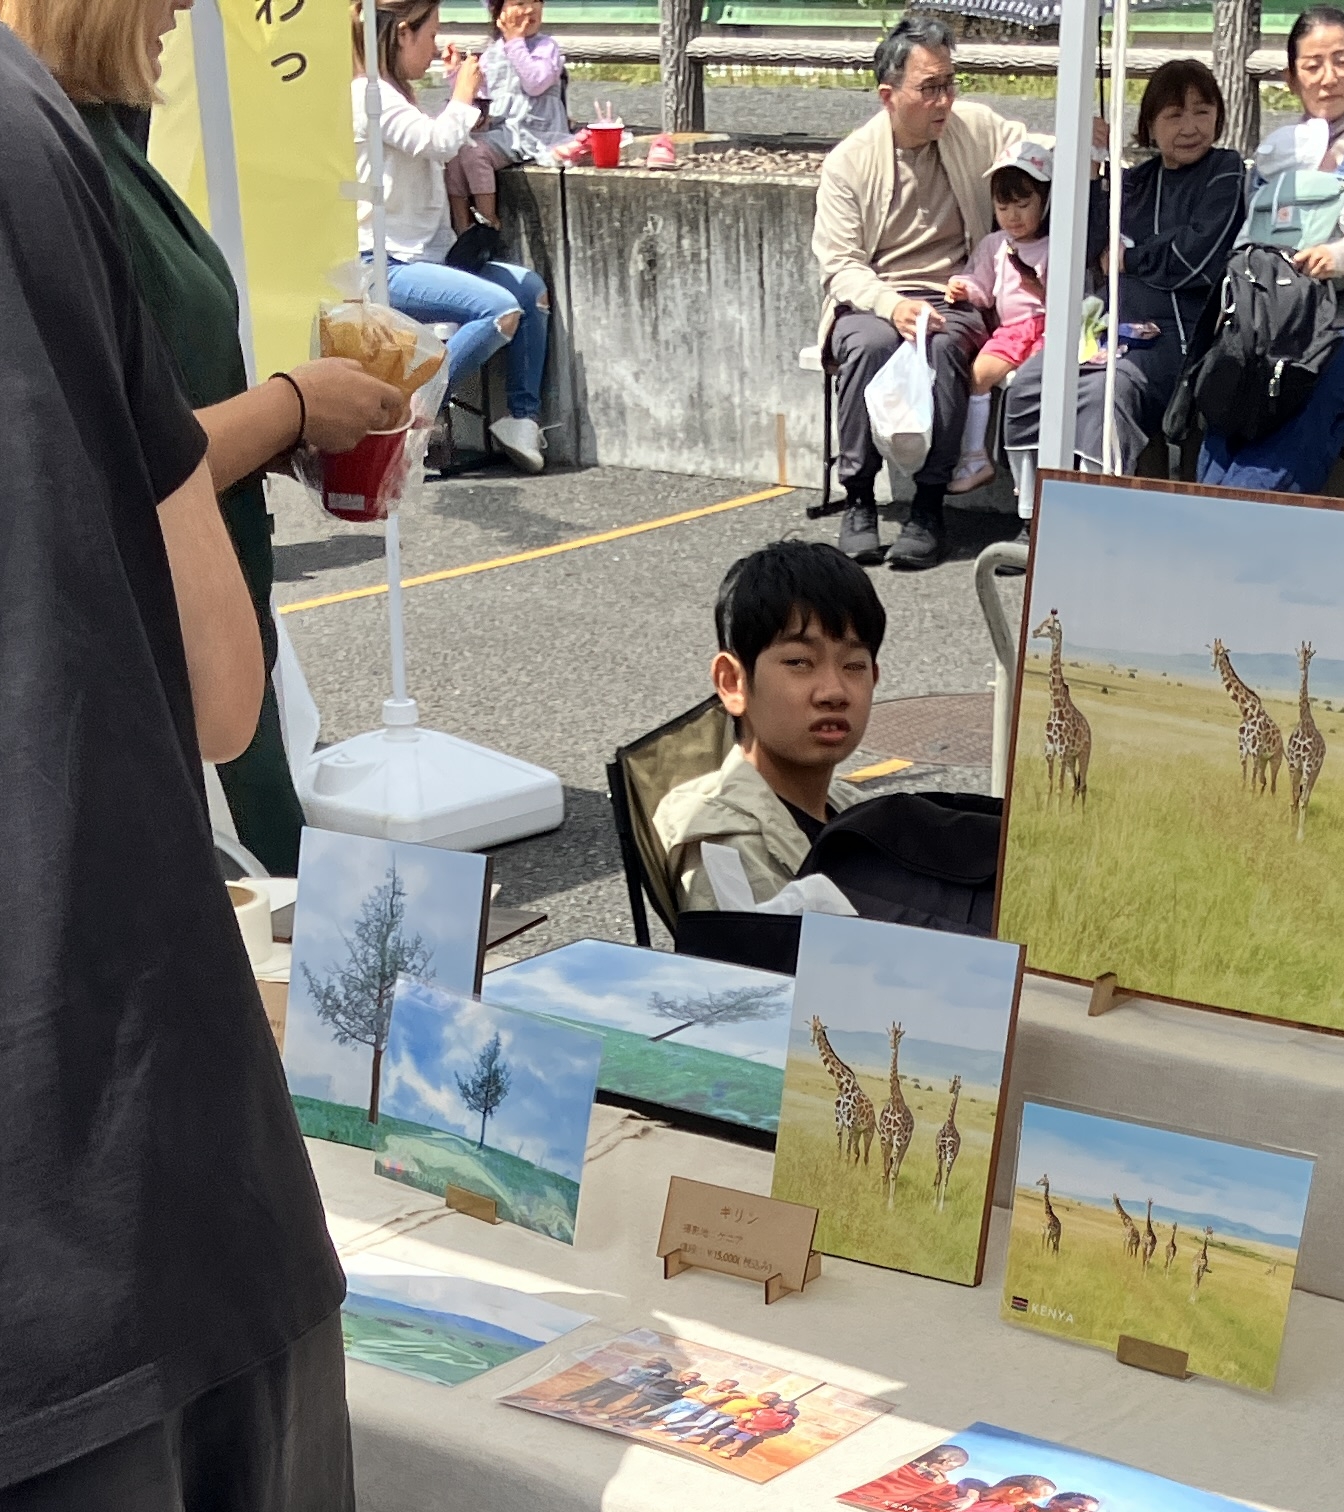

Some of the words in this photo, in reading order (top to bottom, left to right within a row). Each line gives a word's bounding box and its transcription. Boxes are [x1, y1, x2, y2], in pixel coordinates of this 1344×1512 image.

[719, 1206, 760, 1225] キリン
[1031, 1303, 1074, 1324] KENYA
